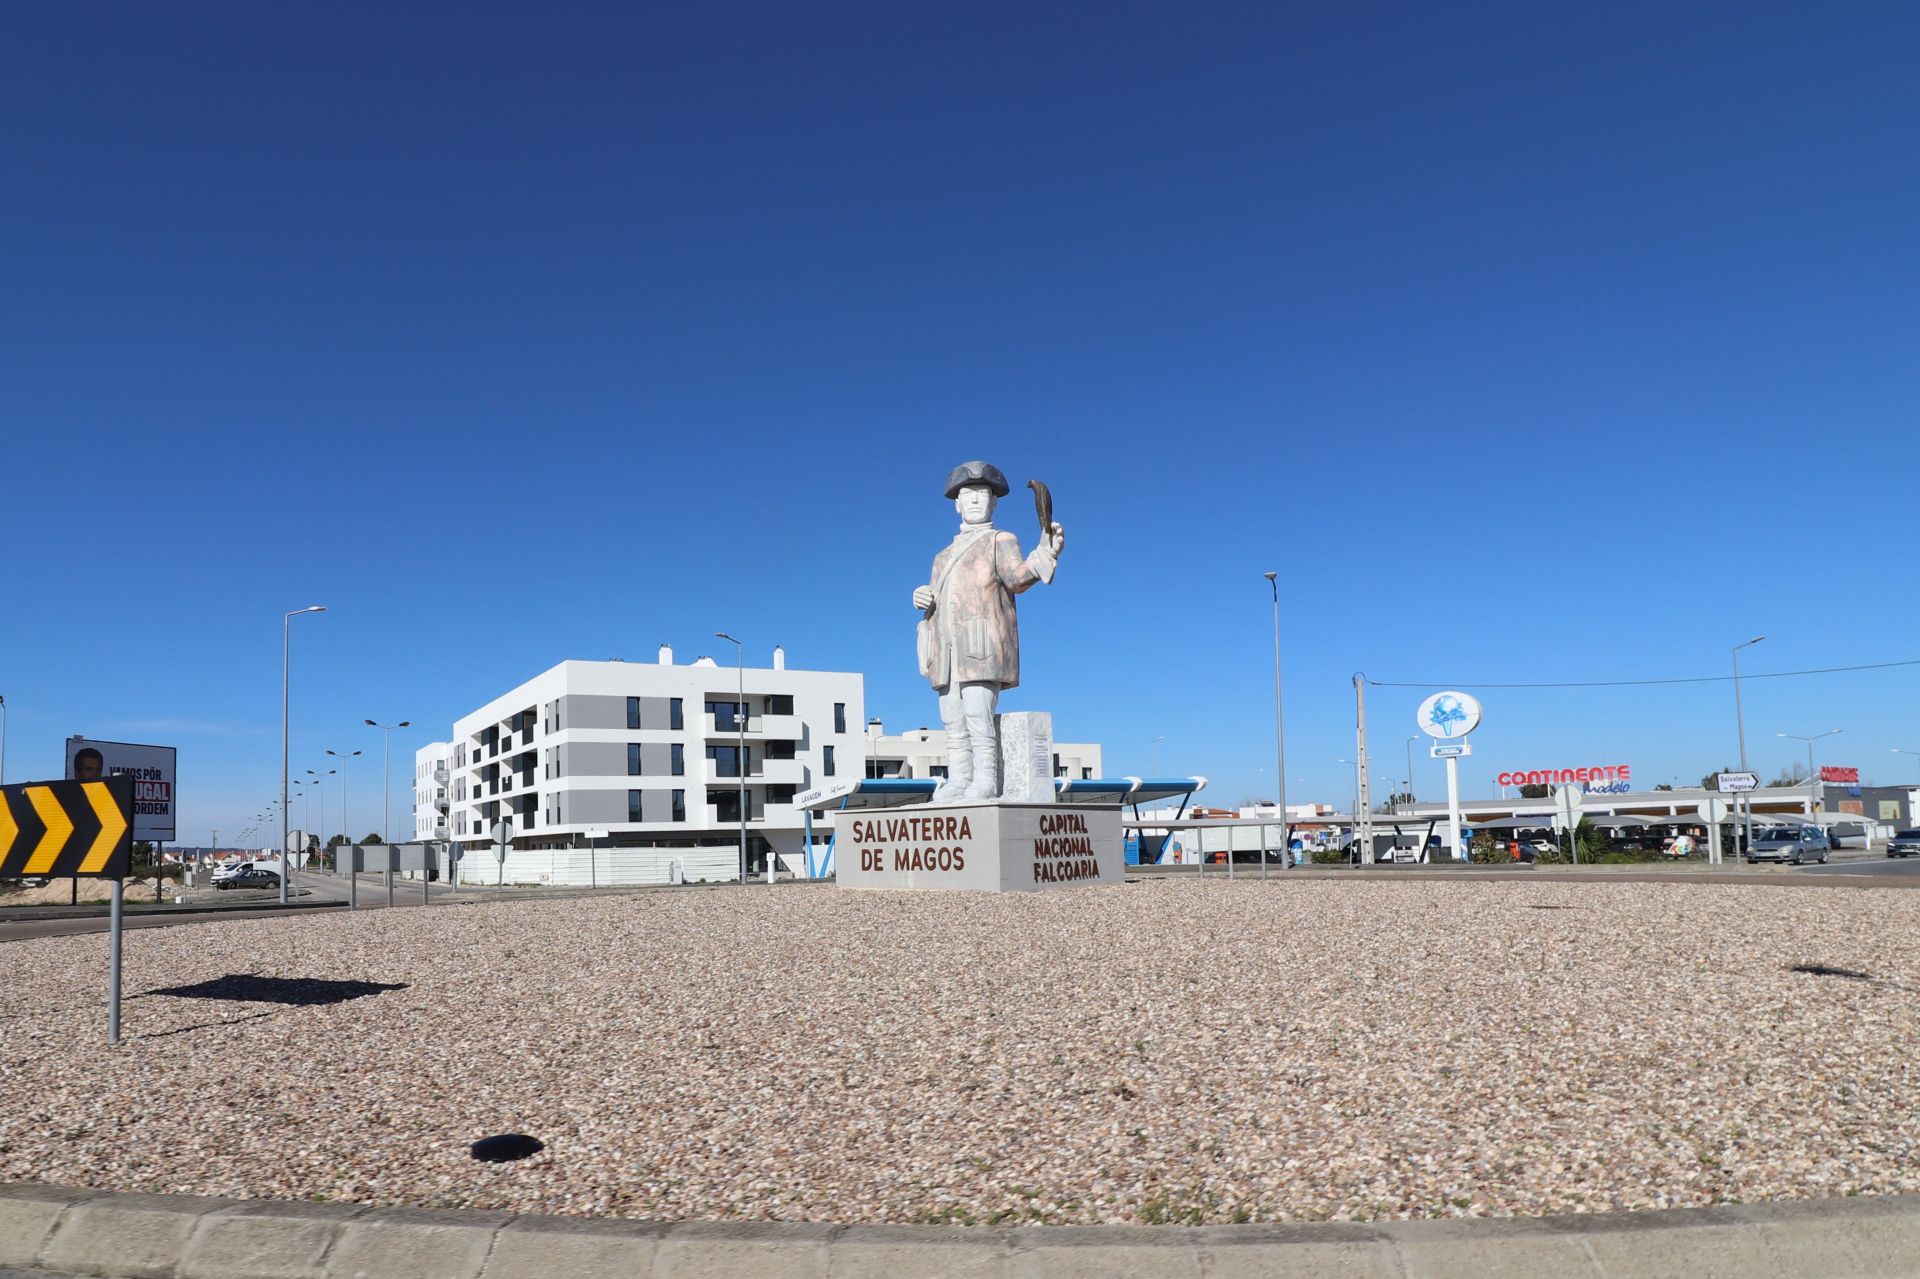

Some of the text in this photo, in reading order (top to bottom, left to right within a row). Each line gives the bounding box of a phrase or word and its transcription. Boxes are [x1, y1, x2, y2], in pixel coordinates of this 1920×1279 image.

[143, 767, 162, 780] PÔR
[1498, 765, 1630, 787] CONTINENTE
[135, 782, 169, 801] UGAL
[1583, 781, 1630, 794] modelo
[134, 802, 169, 815] ORDEM
[852, 816, 973, 843] SALVATERRA
[1039, 814, 1088, 836] CAPITAL
[861, 846, 965, 872] DE MAGOS
[1034, 837, 1094, 859] NACIONAL
[1033, 859, 1100, 884] FALCOARIA
